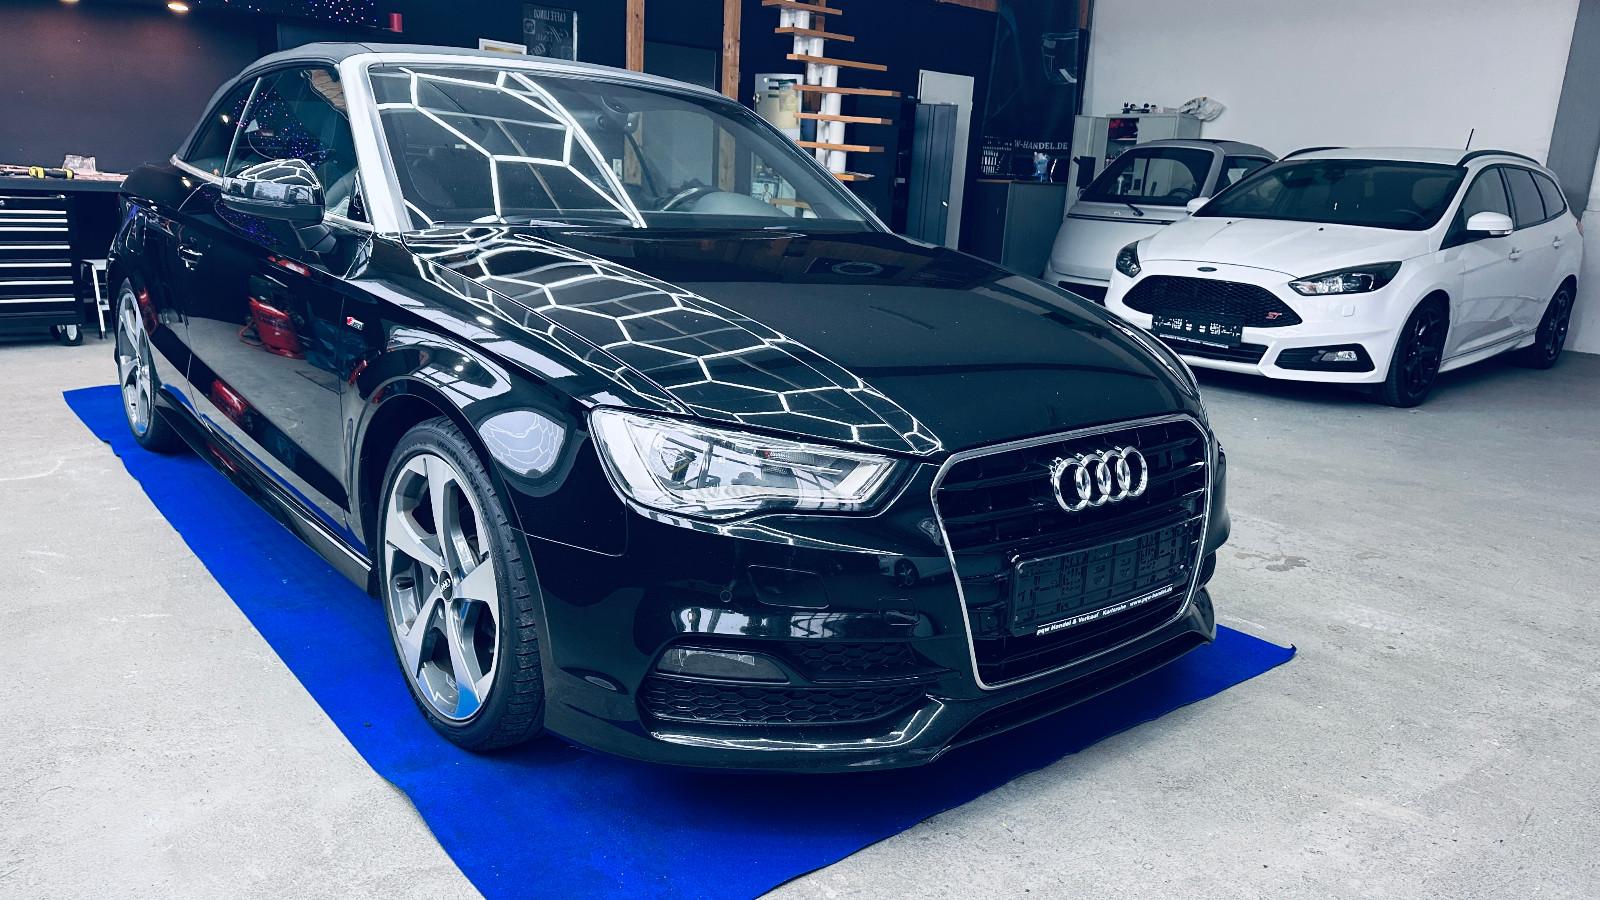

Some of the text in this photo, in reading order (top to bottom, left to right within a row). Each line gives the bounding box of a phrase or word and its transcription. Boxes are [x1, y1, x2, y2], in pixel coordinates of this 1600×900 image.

[1265, 312, 1282, 320] ST
[1051, 620, 1072, 631] Handel
[1078, 612, 1100, 623] Verkauf
[1102, 604, 1127, 615] Karlsruhe
